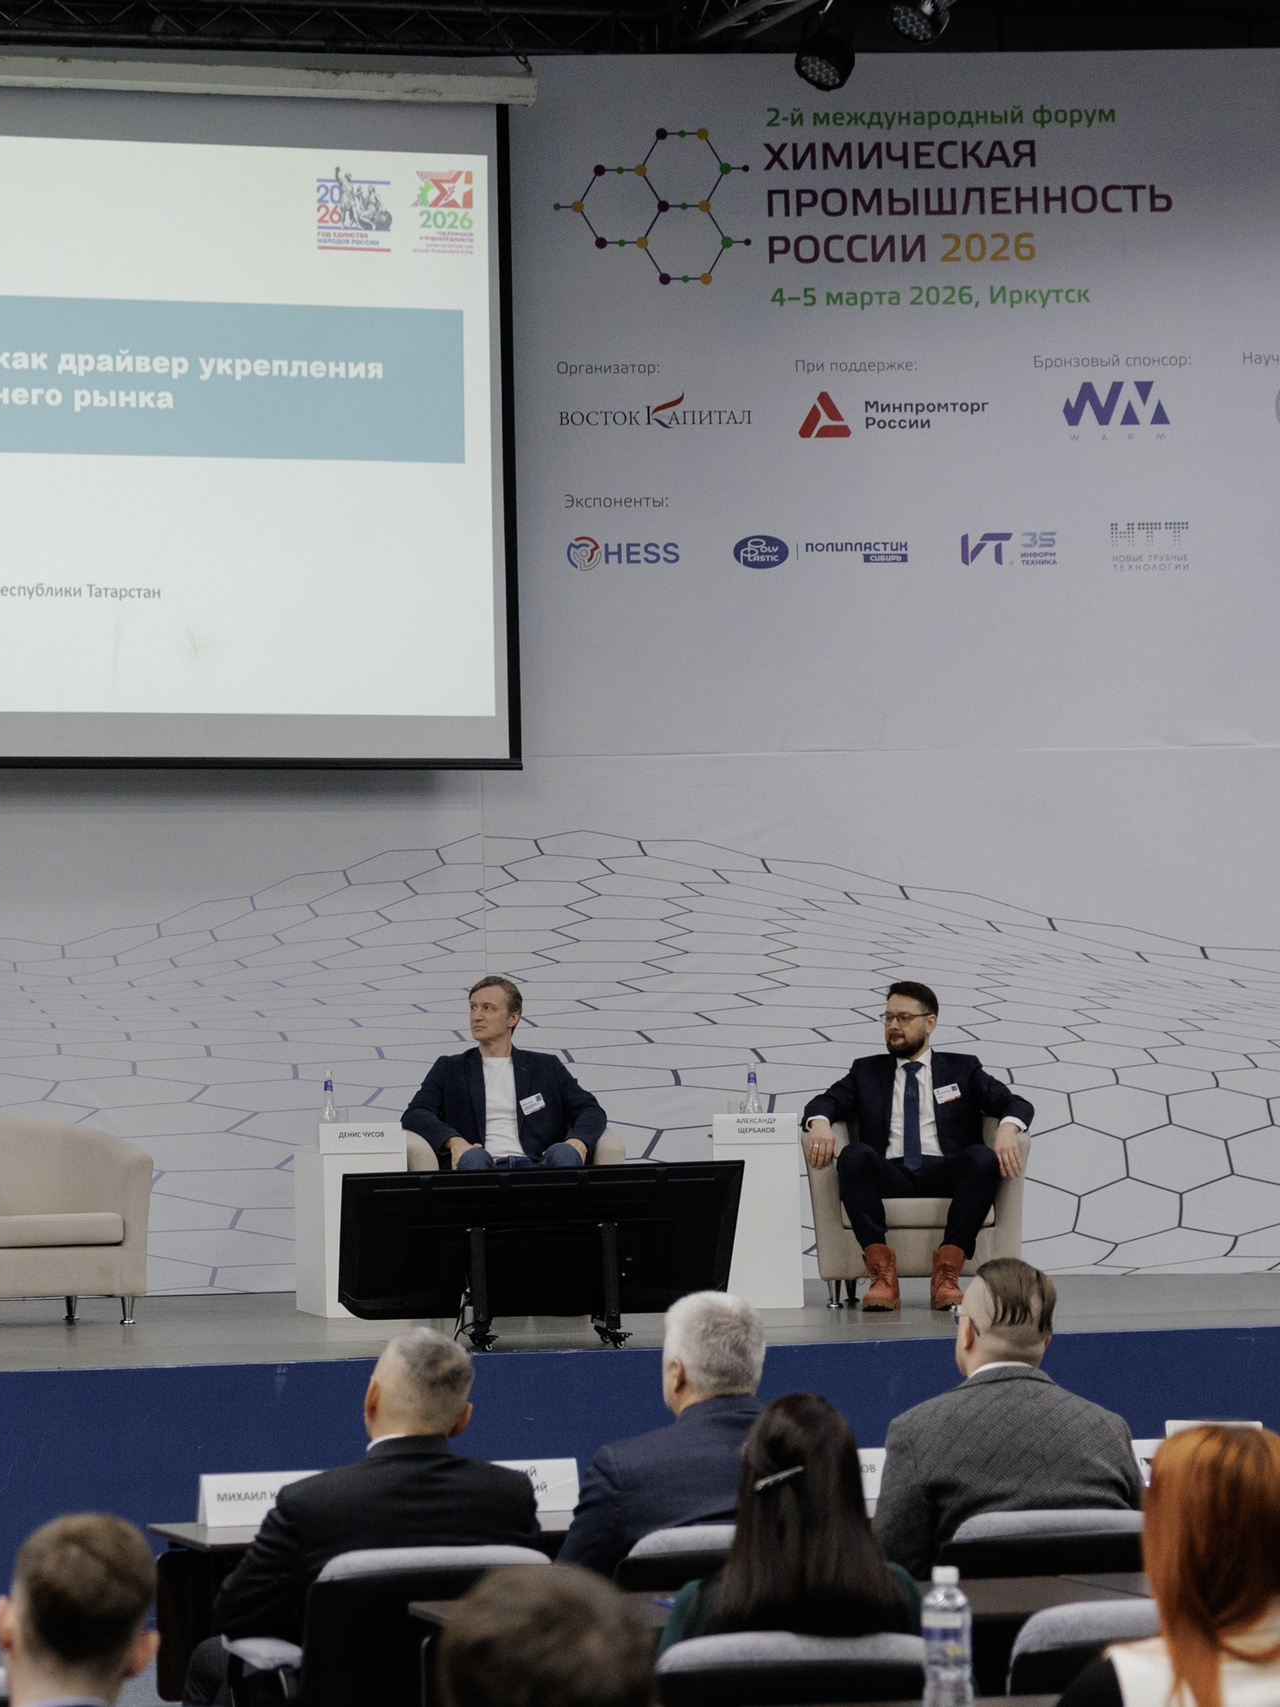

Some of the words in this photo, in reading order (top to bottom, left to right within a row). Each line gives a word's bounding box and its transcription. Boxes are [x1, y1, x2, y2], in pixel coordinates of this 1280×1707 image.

[766, 107, 804, 127] 2-й
[812, 105, 1023, 130] международный
[1032, 105, 1116, 126] форум
[763, 140, 1037, 171] ХИМИЧЕСКАЯ
[317, 184, 343, 204] 20
[767, 184, 1173, 217] ПРОМЫШЛЕННОСТЬ
[317, 205, 343, 224] 26
[420, 211, 474, 230] 2026
[768, 235, 926, 264] РОССИИ
[940, 232, 1036, 262] 2026
[826, 289, 901, 310] марта
[909, 286, 980, 309] 2026,
[989, 286, 1091, 308] Иркутск
[57, 348, 189, 378] драйвер
[199, 356, 383, 380] укрепления
[556, 360, 661, 377] Организатор:
[794, 359, 825, 375] При
[829, 360, 918, 374] поддержке:
[1033, 355, 1120, 370] Бронзовый
[1125, 355, 1192, 371] спонсор:
[74, 388, 175, 411] рынка
[864, 399, 989, 415] Минпромторг
[559, 410, 641, 426] ВОСТОК
[865, 417, 931, 430] России
[1068, 431, 1167, 442] WARM
[564, 495, 669, 509] Экспоненты:
[605, 543, 679, 564] HESS
[804, 541, 909, 553] ПОЛИПЛАСТИК
[1020, 551, 1057, 559] ИНФОРМ
[869, 554, 902, 562] СИБИРЬ
[1021, 558, 1058, 566] ТЕХНИКА
[1112, 554, 1143, 563] НОВЫЕ
[1148, 553, 1189, 563] ТРУБНЫЕ
[1113, 563, 1191, 572] ТЕХНОЛОГИИ
[86, 584, 162, 601] Татарстан
[338, 1131, 361, 1139] ДЕНИС
[216, 1491, 268, 1503] МИХАИЛ
